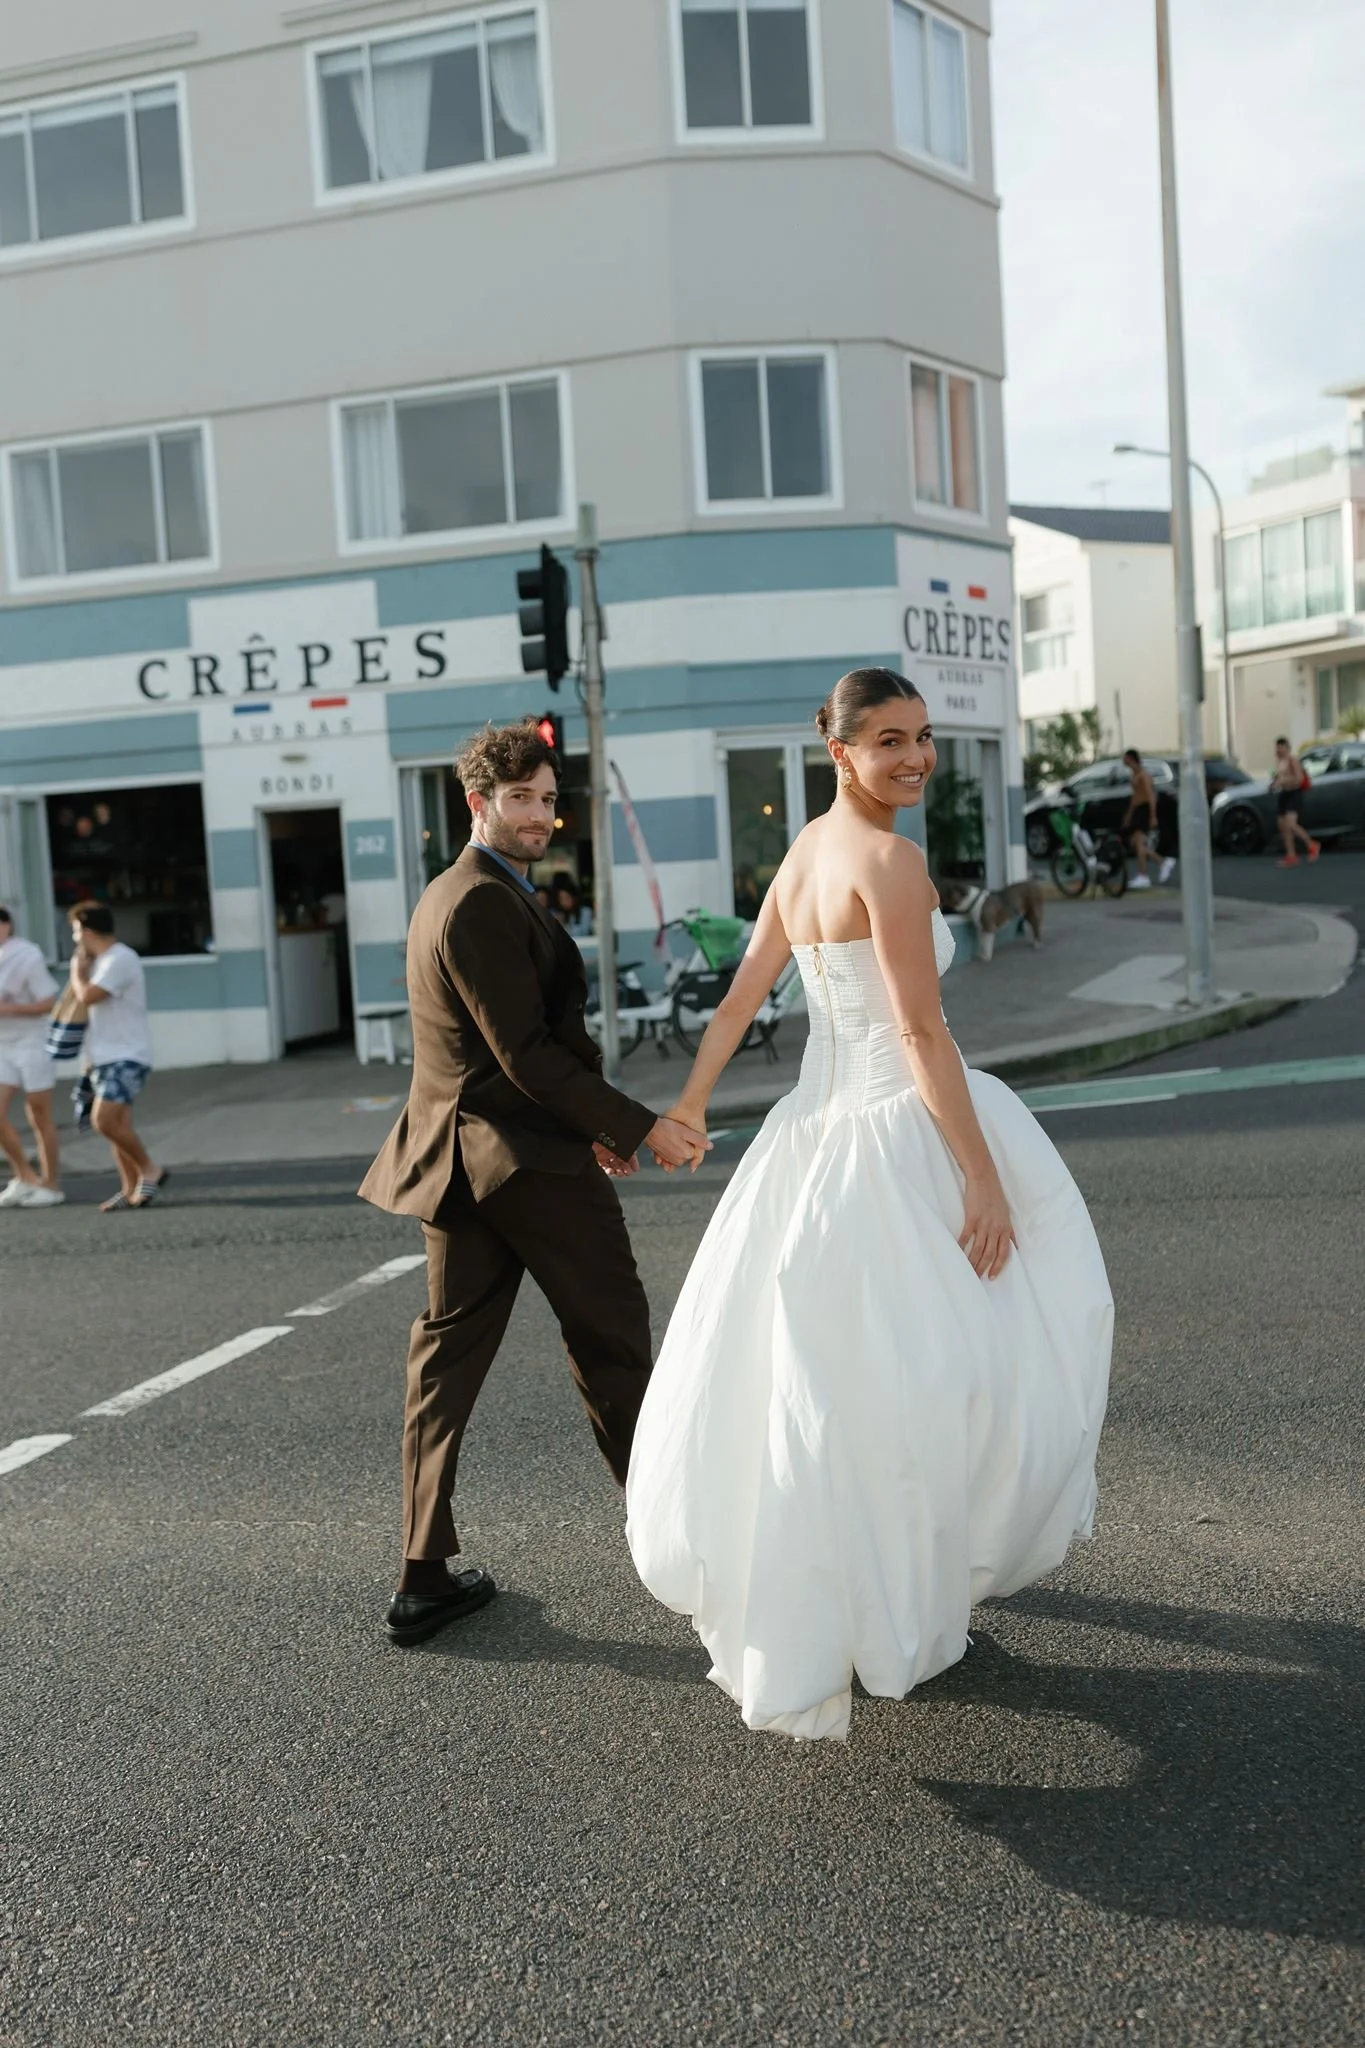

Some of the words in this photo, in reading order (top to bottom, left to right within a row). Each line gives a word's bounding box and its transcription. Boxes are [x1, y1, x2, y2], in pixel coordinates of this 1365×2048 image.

[904, 600, 1011, 664] CRÊPES
[137, 629, 448, 700] CRÊPES
[946, 694, 977, 712] PARIS
[260, 773, 334, 795] BONDI
